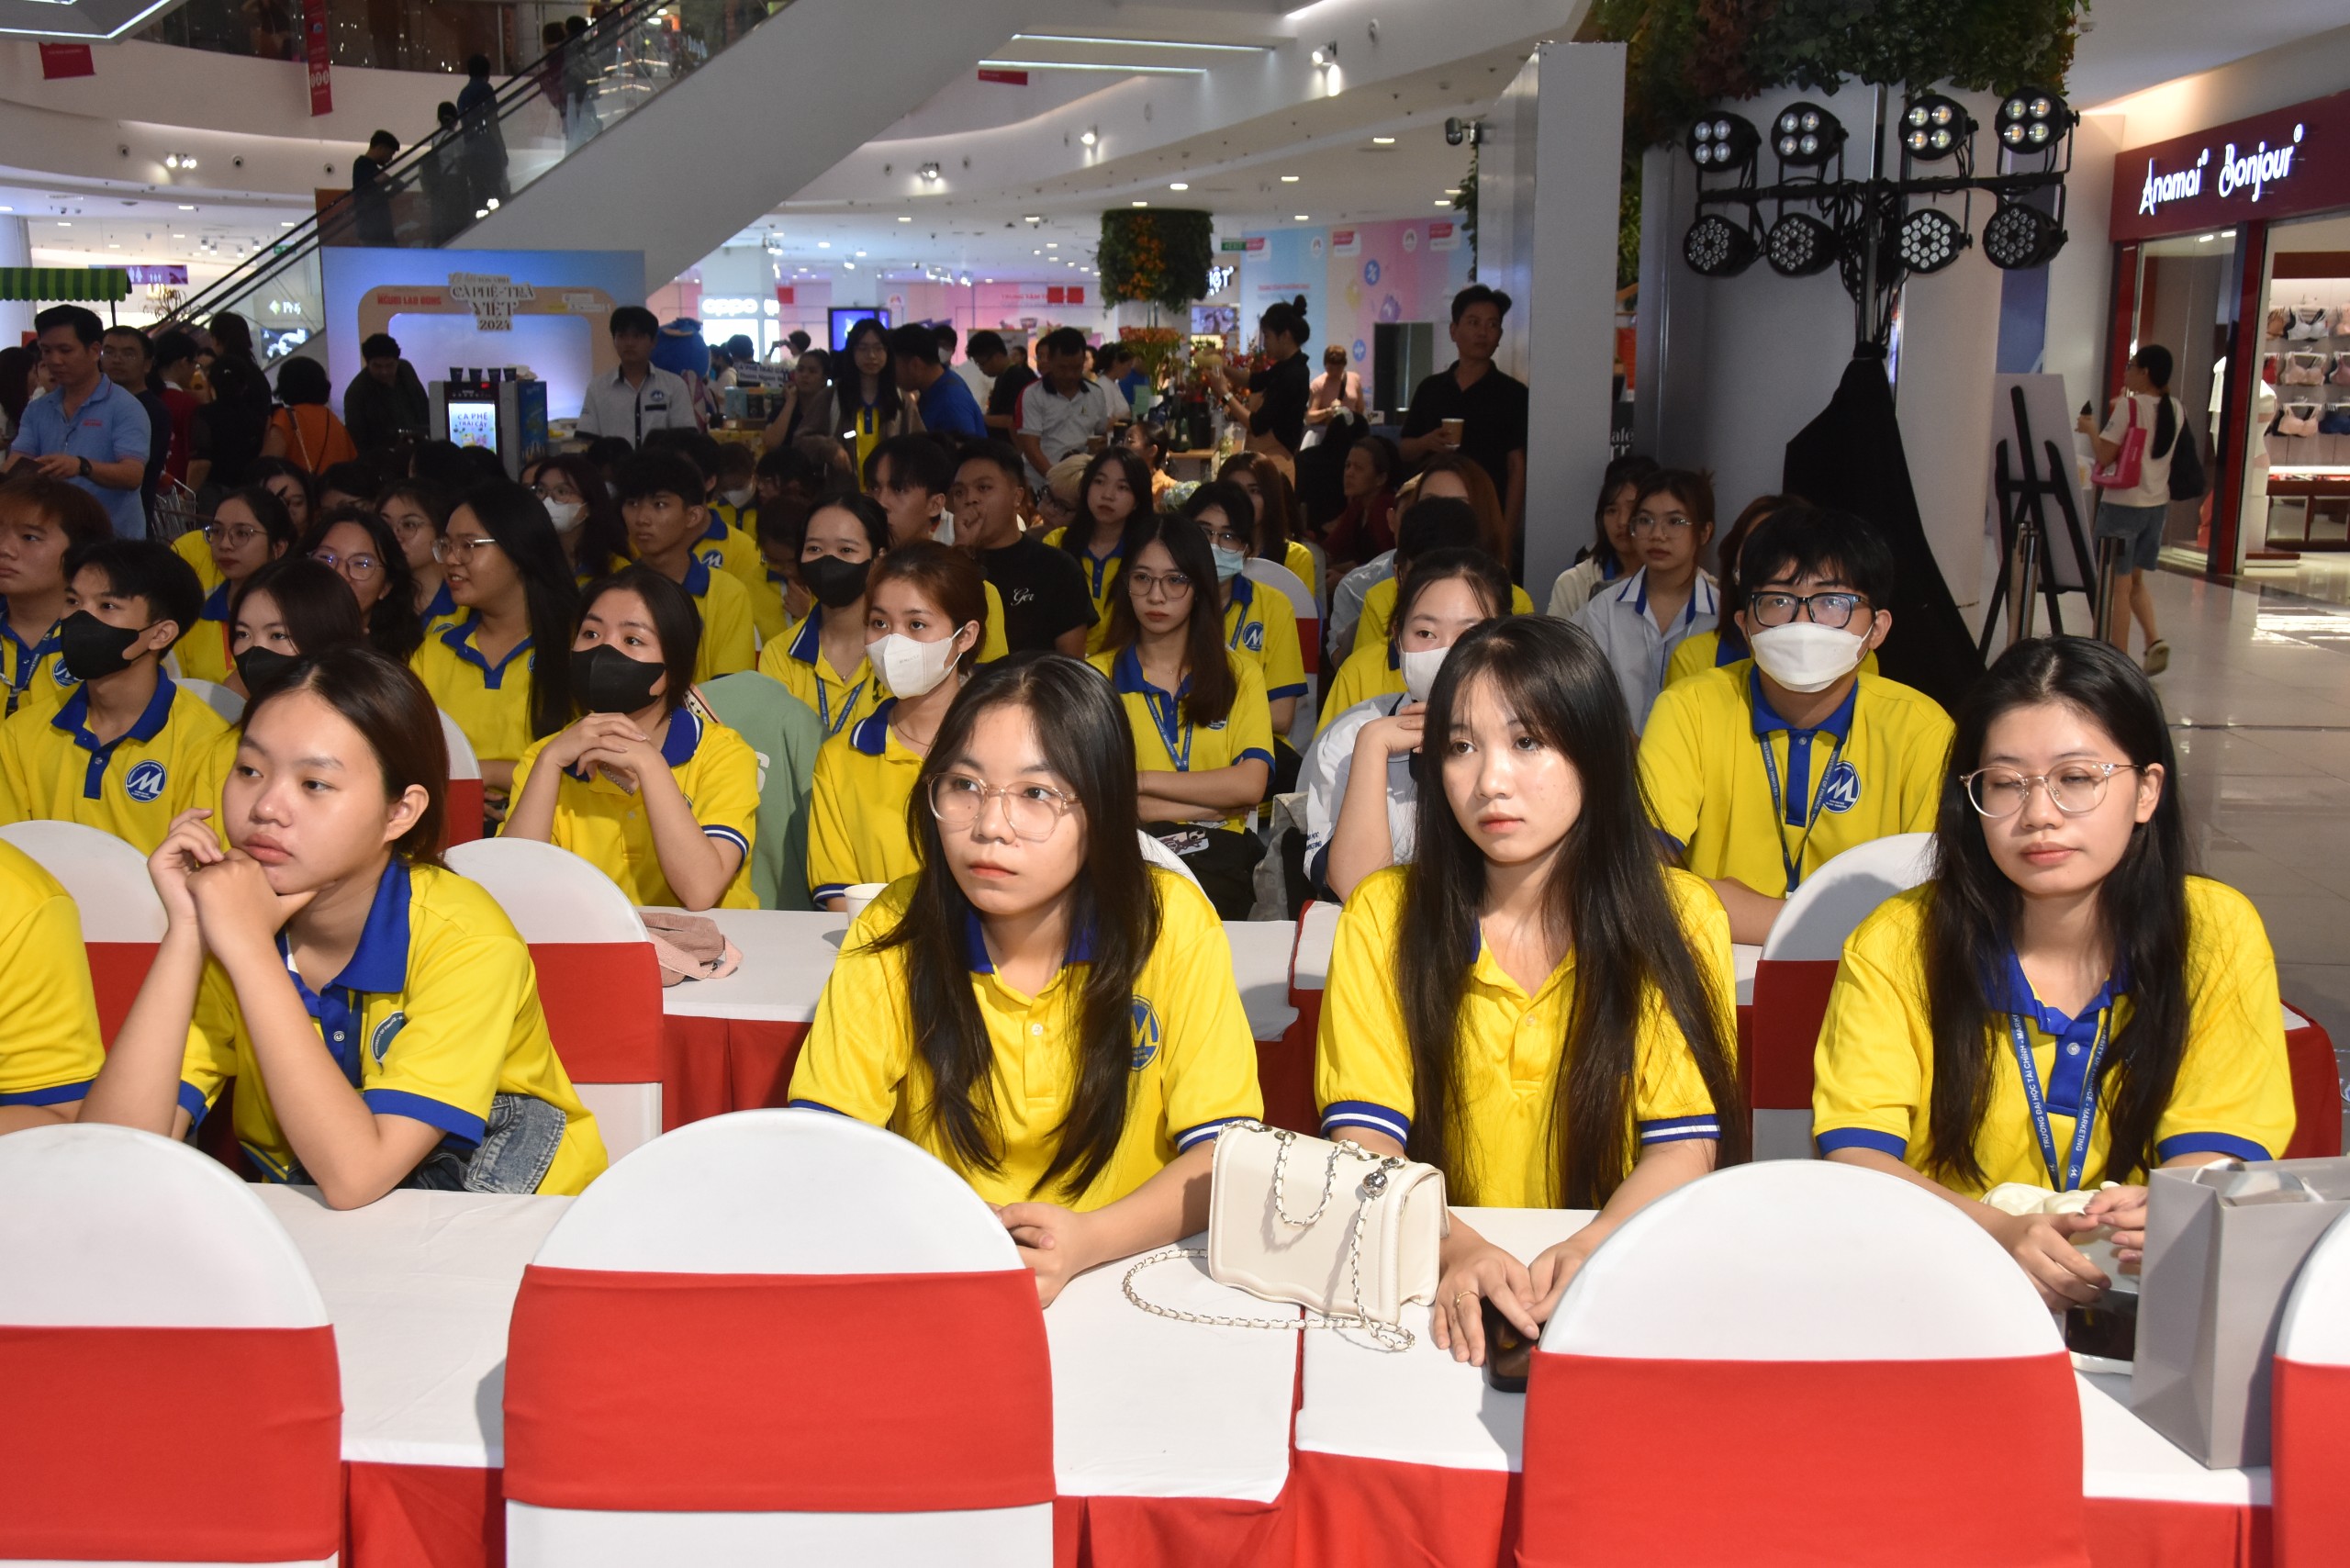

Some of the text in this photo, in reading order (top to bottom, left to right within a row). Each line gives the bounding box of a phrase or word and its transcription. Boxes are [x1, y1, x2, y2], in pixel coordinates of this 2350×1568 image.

[2138, 143, 2294, 216] Anamai Bonjour
[479, 319, 510, 331] 2024
[2020, 1046, 2031, 1070] CHÍNH
[2031, 1083, 2040, 1101] HỌC
[2035, 1103, 2043, 1115] ĐẠI
[2037, 1116, 2051, 1148] TRƯỜNG
[2076, 1107, 2091, 1152] MARKETING
